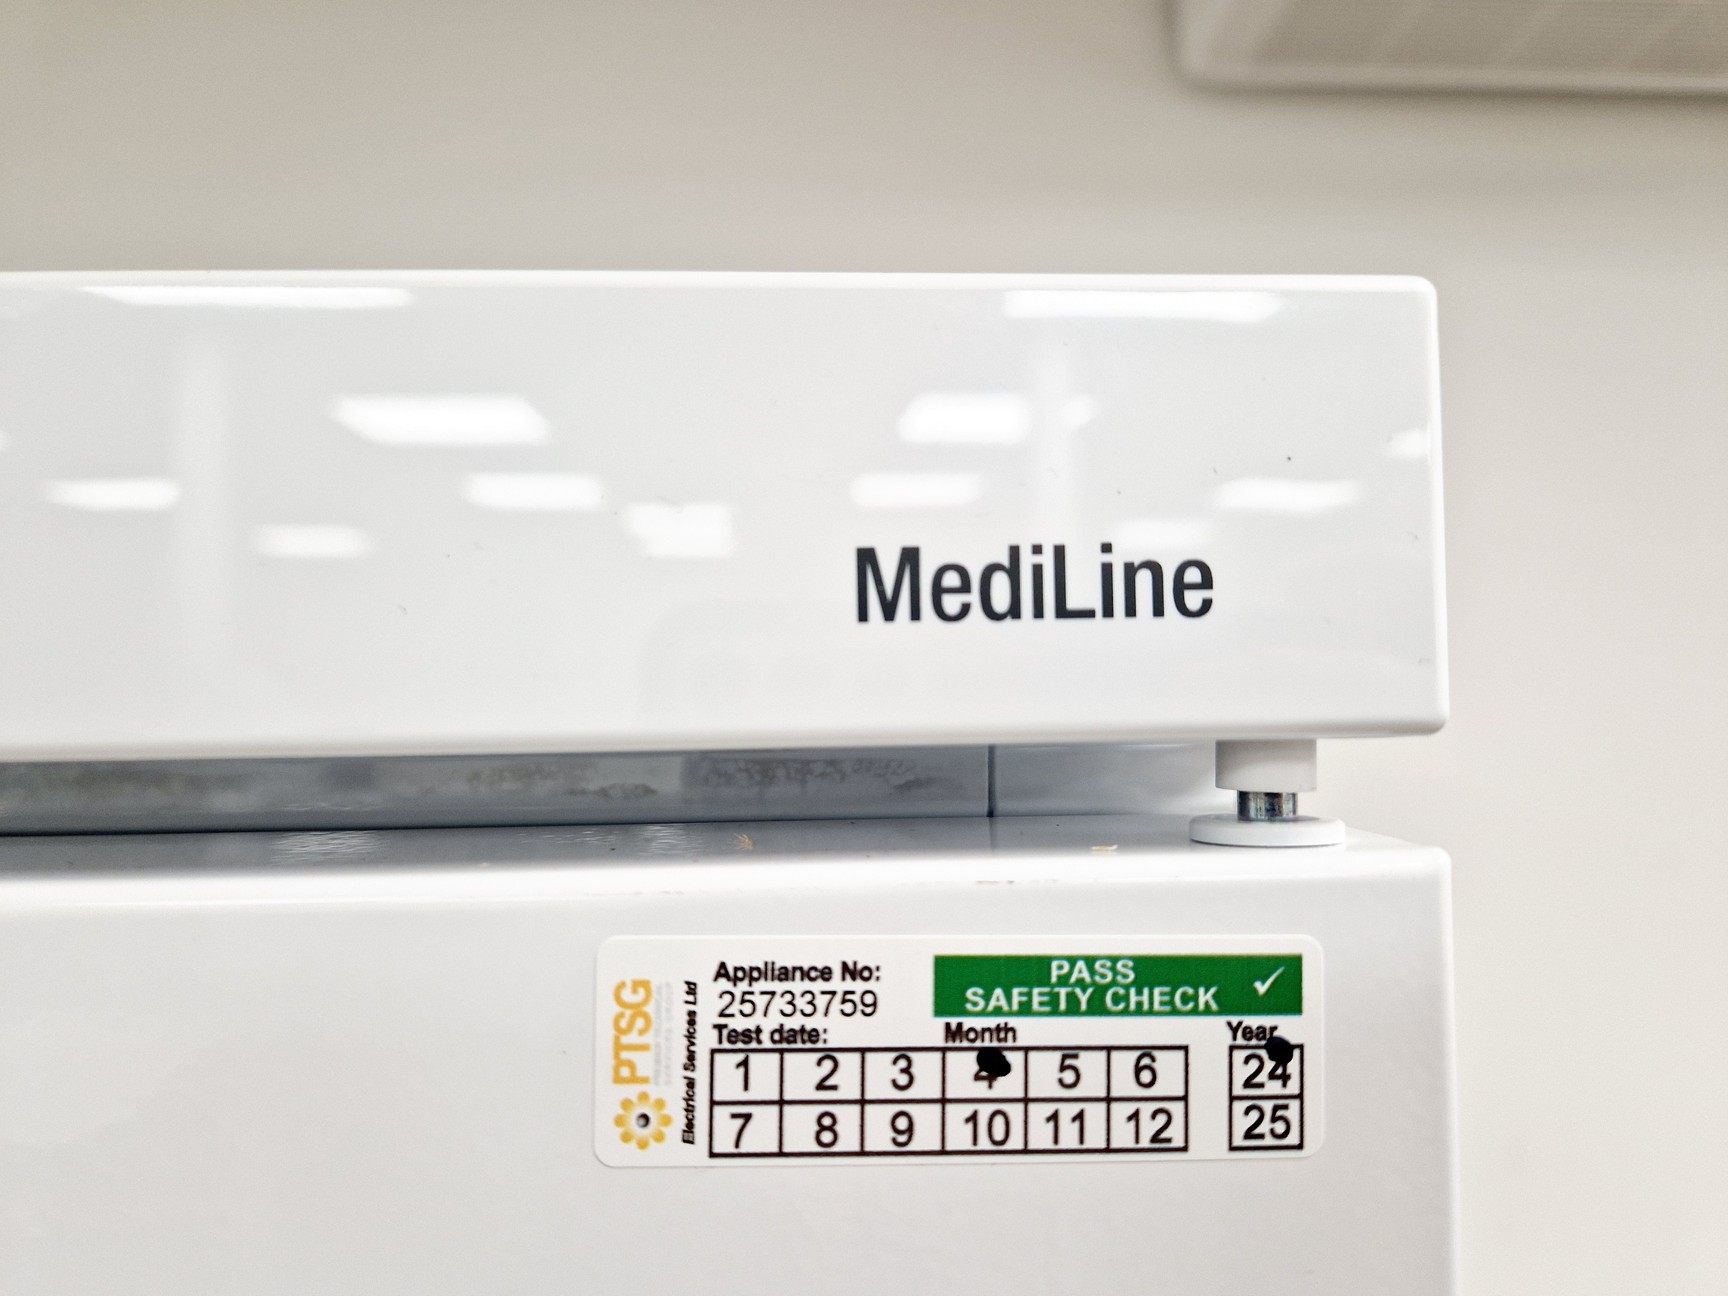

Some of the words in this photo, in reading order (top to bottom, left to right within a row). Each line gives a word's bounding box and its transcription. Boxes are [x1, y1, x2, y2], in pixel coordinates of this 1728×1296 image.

[856, 542, 1214, 623] MediLine
[713, 960, 833, 988] Appliance
[841, 960, 880, 983] No:
[1050, 959, 1135, 984] PASS
[684, 980, 698, 1006] Ltd
[717, 989, 878, 1018] 25733759
[965, 987, 1093, 1012] SAFETY
[1105, 986, 1218, 1011] CHECK
[611, 978, 654, 1087] PTSG
[682, 1009, 697, 1073] Services
[712, 1023, 763, 1046] Test
[769, 1023, 827, 1046] date:
[944, 1021, 1017, 1044] Month
[1226, 1019, 1278, 1041] Year
[735, 1054, 751, 1092] 1
[814, 1052, 839, 1092] 2
[891, 1052, 915, 1092] 3
[1057, 1052, 1081, 1090] 5
[1133, 1051, 1158, 1089] 6
[1242, 1052, 1292, 1090] 24
[681, 1076, 696, 1145] Electrical
[1242, 1103, 1291, 1141] 25
[730, 1112, 753, 1150] 7
[814, 1110, 839, 1149] 8
[890, 1110, 914, 1148] 9
[964, 1109, 1011, 1147] 10
[1045, 1108, 1085, 1146] 11
[1126, 1107, 1173, 1145] 12
